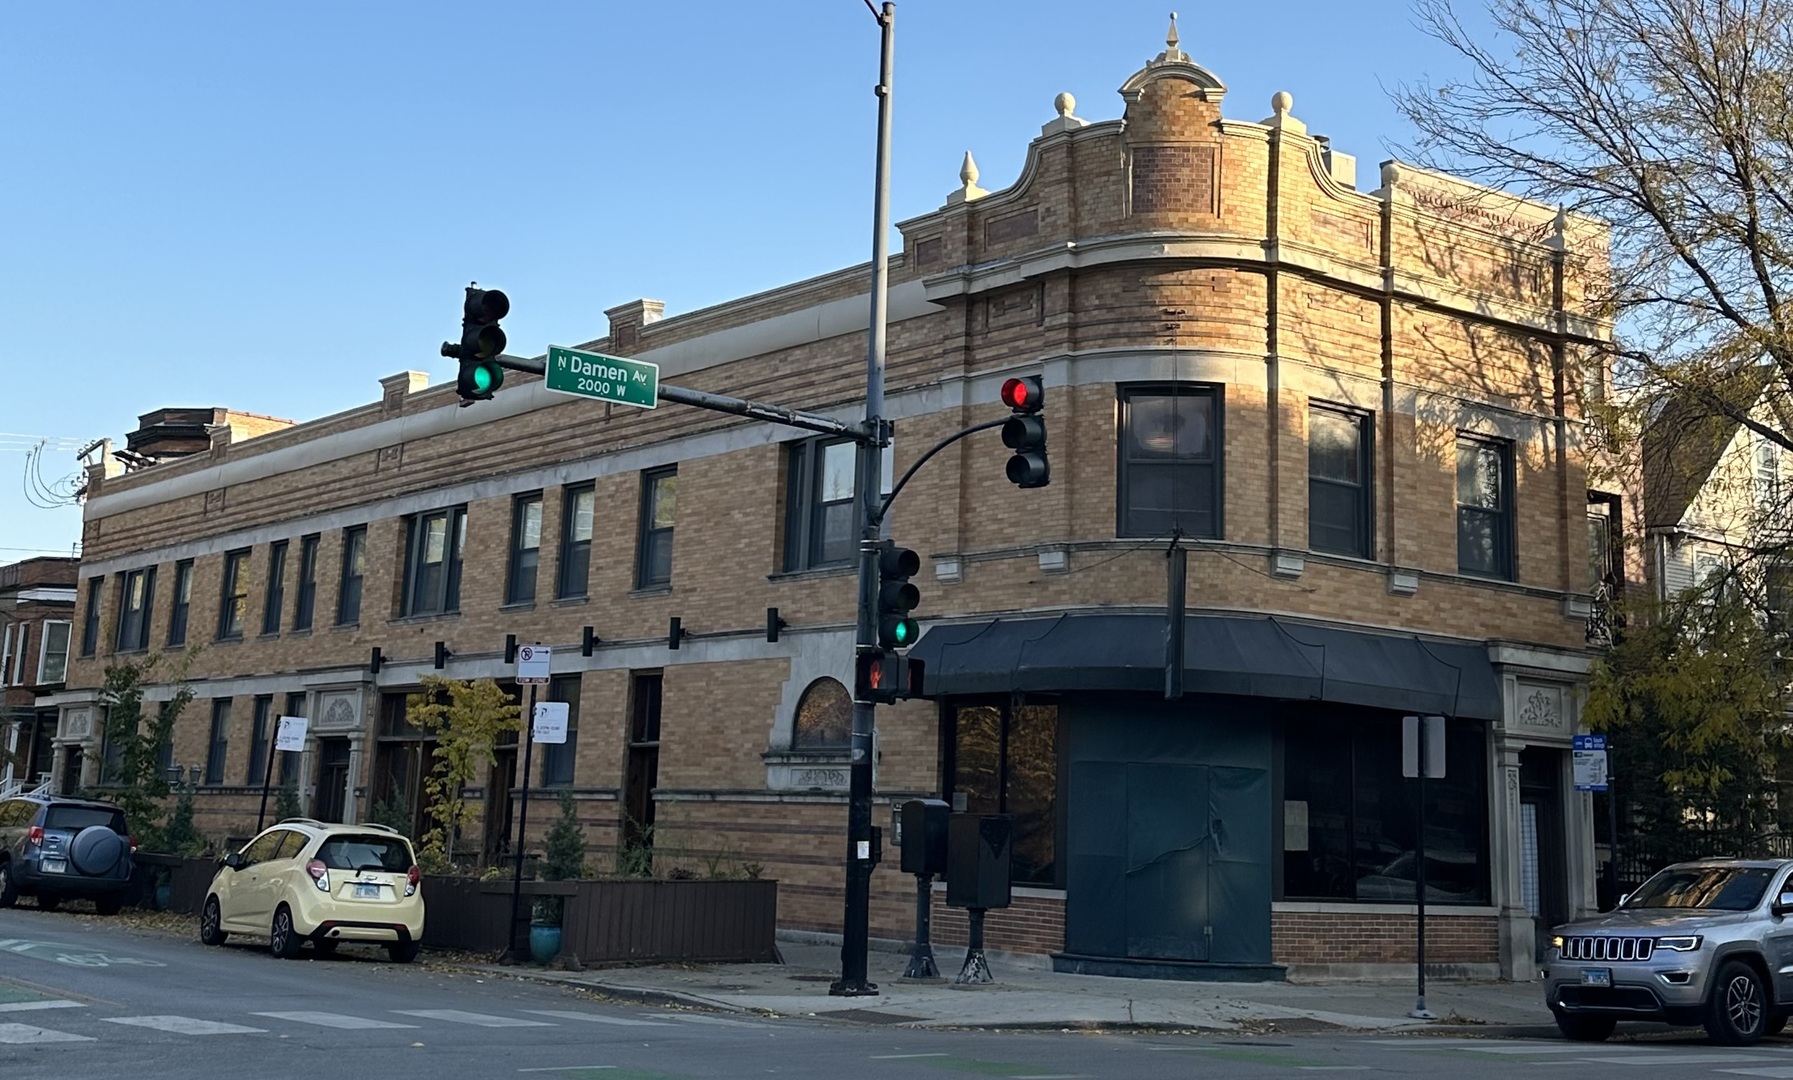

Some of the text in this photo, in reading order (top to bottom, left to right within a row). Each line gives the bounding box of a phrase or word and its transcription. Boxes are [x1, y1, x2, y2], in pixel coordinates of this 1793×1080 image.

[558, 355, 648, 383] N Damen Av
[577, 378, 627, 397] 2000 W
